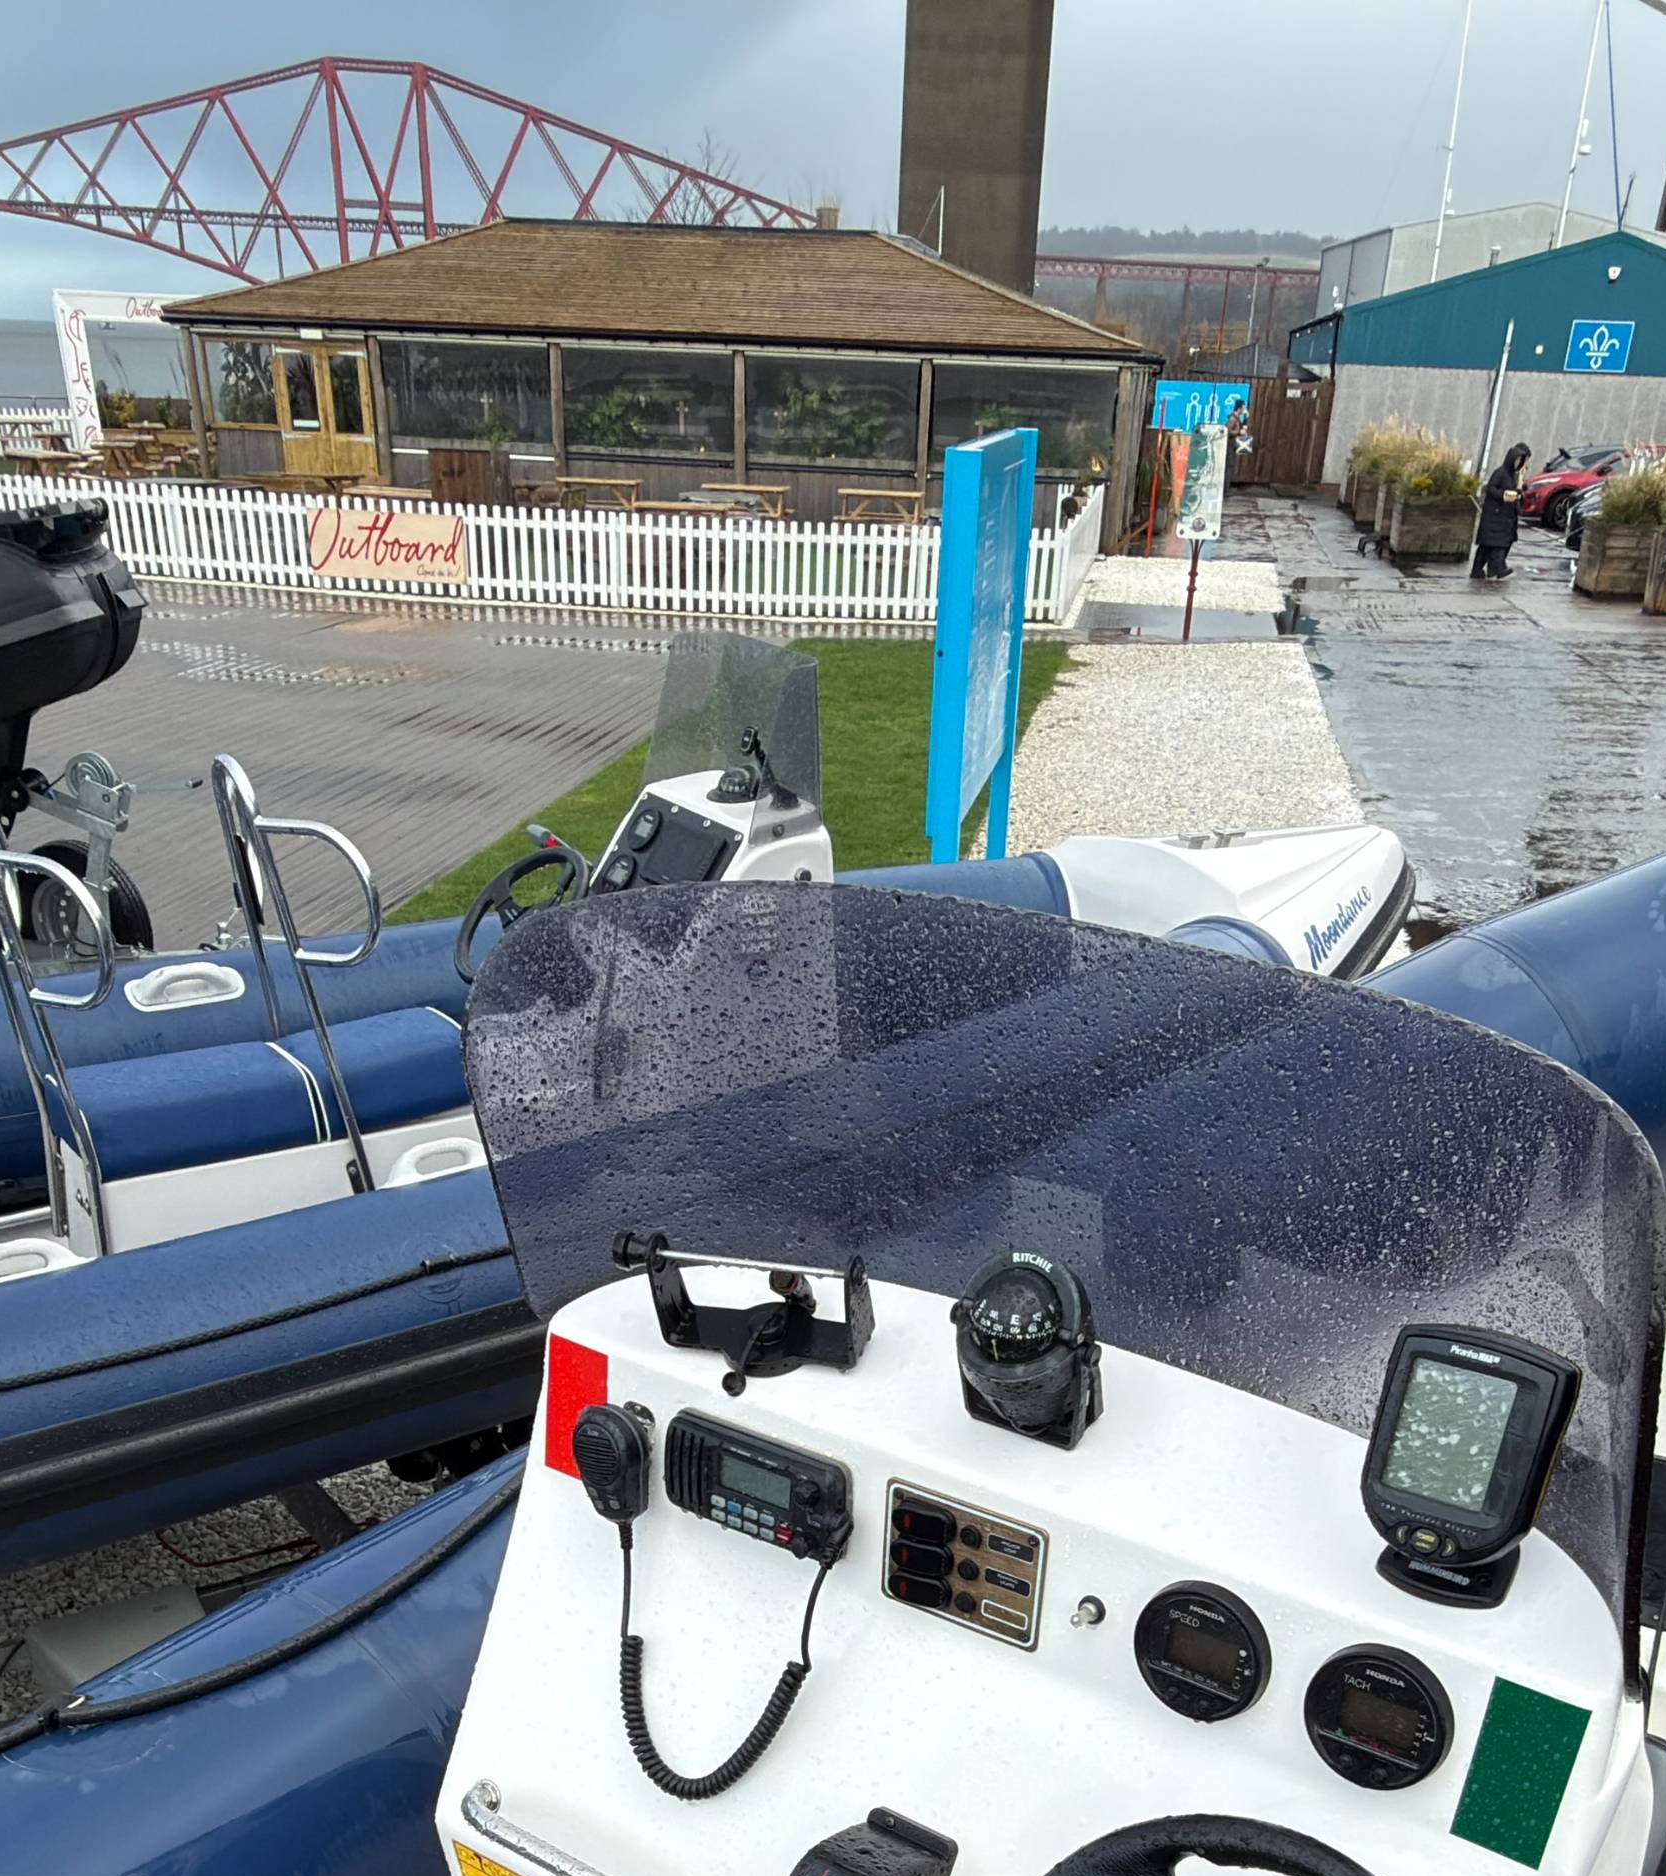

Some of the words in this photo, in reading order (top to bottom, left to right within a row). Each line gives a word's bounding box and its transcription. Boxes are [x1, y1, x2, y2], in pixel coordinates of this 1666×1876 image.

[125, 296, 164, 319] Outboa
[309, 508, 464, 570] Outboard
[1303, 885, 1372, 971] Moondance
[1013, 1252, 1053, 1273] RITCHIE
[1169, 1608, 1201, 1629] SPEED
[1189, 1604, 1226, 1624] HONDA
[1343, 1673, 1372, 1692] TACH
[1365, 1668, 1406, 1688] HONDA
